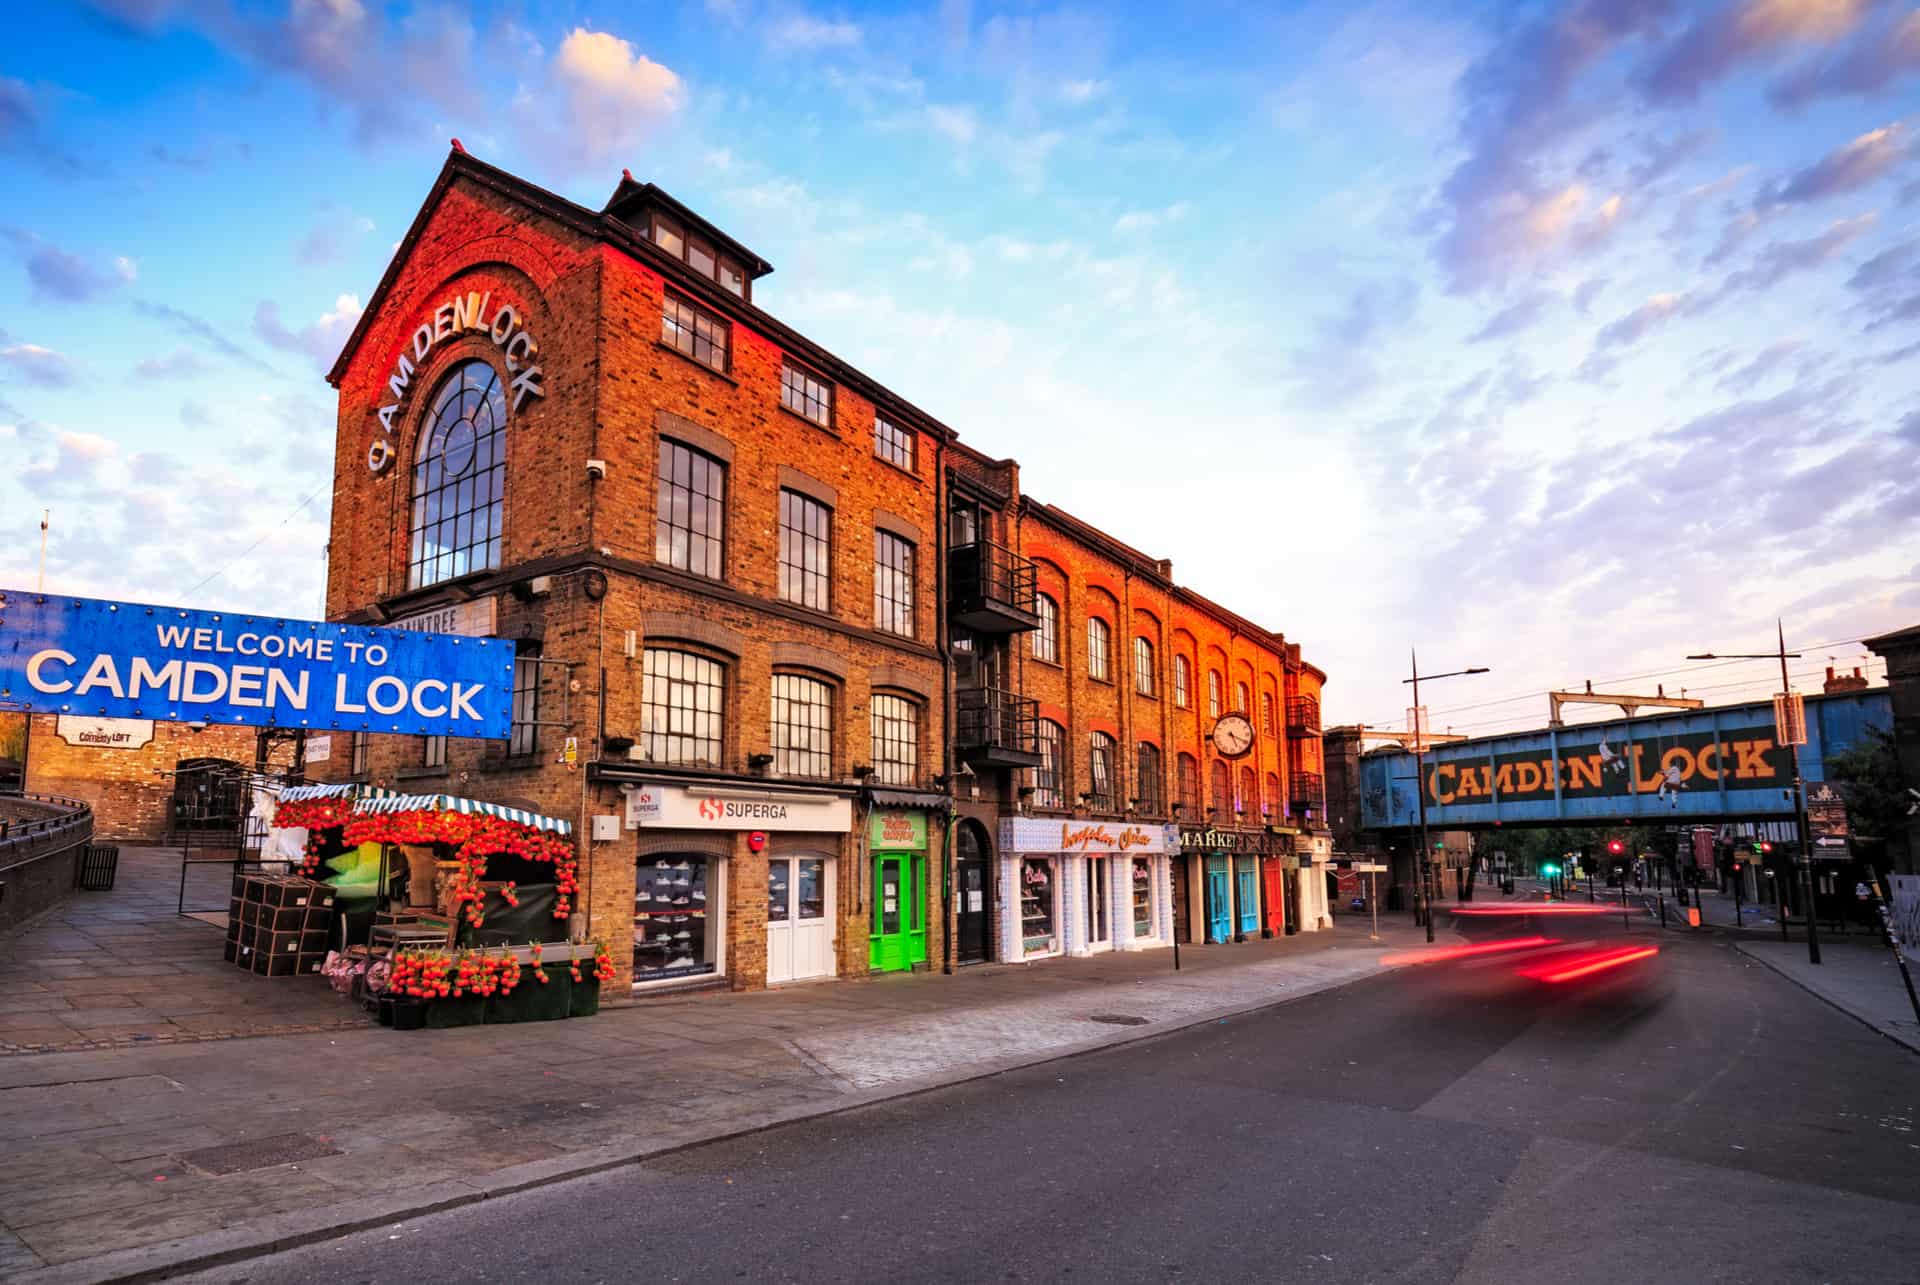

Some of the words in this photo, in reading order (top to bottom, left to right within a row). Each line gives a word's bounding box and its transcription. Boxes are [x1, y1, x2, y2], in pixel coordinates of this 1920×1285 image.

[368, 291, 481, 472] CAMDEN
[475, 291, 545, 411] LOCK
[156, 624, 333, 661] WELCOME
[343, 642, 388, 666] TO
[26, 649, 310, 710] CAMDEN
[335, 673, 485, 721] LOCK
[1428, 754, 1604, 804] CAMDEN
[1624, 739, 1776, 793] LOCK
[726, 802, 787, 818] SUPERGA
[1180, 829, 1236, 848] MARKET
